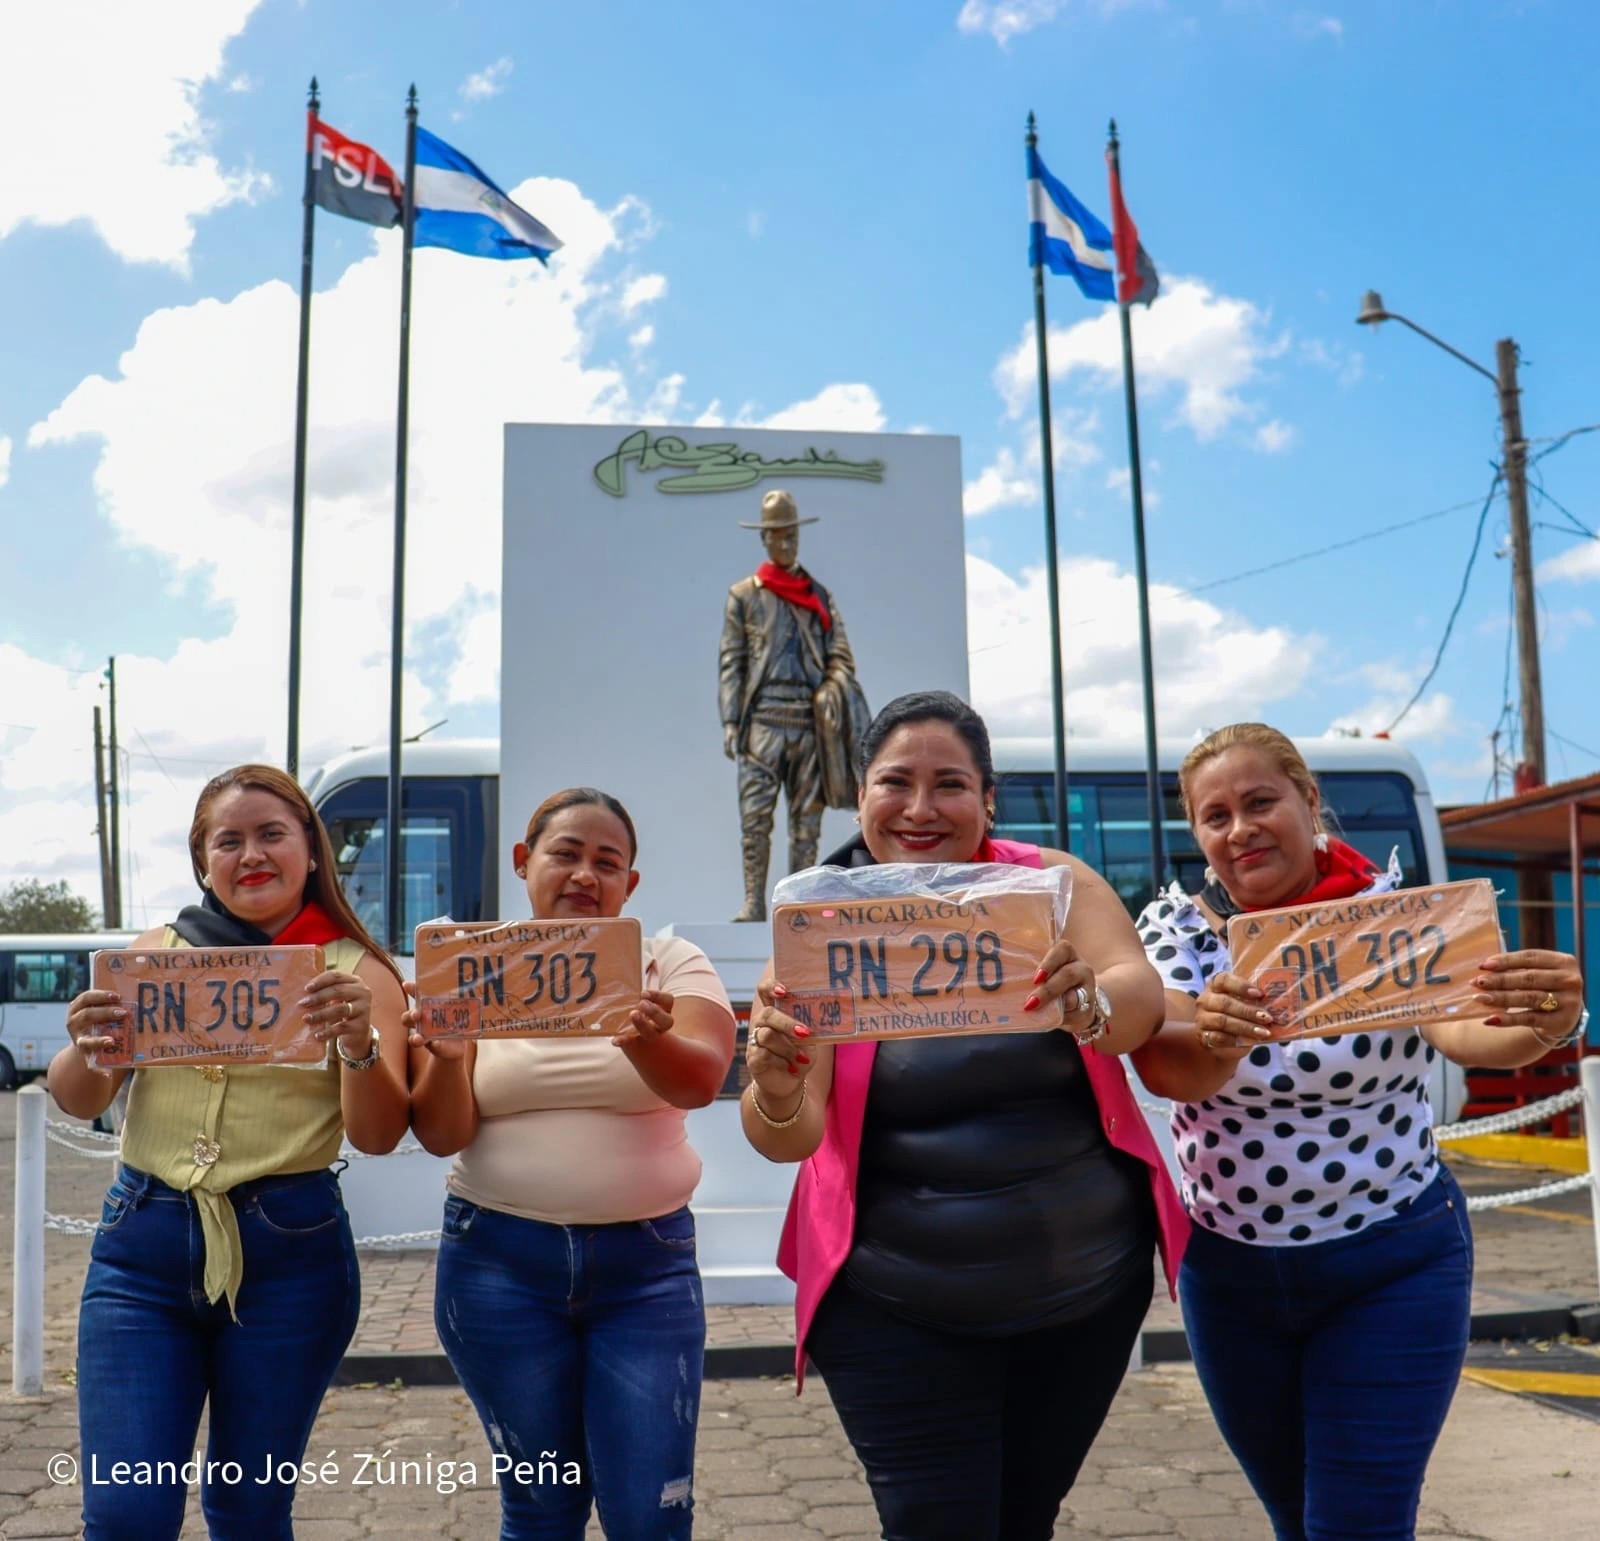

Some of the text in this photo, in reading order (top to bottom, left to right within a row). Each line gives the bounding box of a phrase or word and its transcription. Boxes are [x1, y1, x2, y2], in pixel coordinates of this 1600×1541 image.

[837, 902, 990, 926] NICARAGUA
[1288, 896, 1431, 931] NICARAGUA
[467, 926, 588, 944] NICARAGUA
[149, 952, 272, 970] NICARAGUA
[827, 930, 1003, 999] RN 298
[1281, 924, 1451, 1001] RN 302
[458, 951, 597, 1006] RN 303
[137, 979, 281, 1034] RN 305
[1303, 1003, 1440, 1029] CENTROAMERICA
[480, 1017, 585, 1033] ENTROAMERICA
[857, 1010, 991, 1032] ENTROAMERICA
[151, 1044, 268, 1059] CENTROAMERICA
